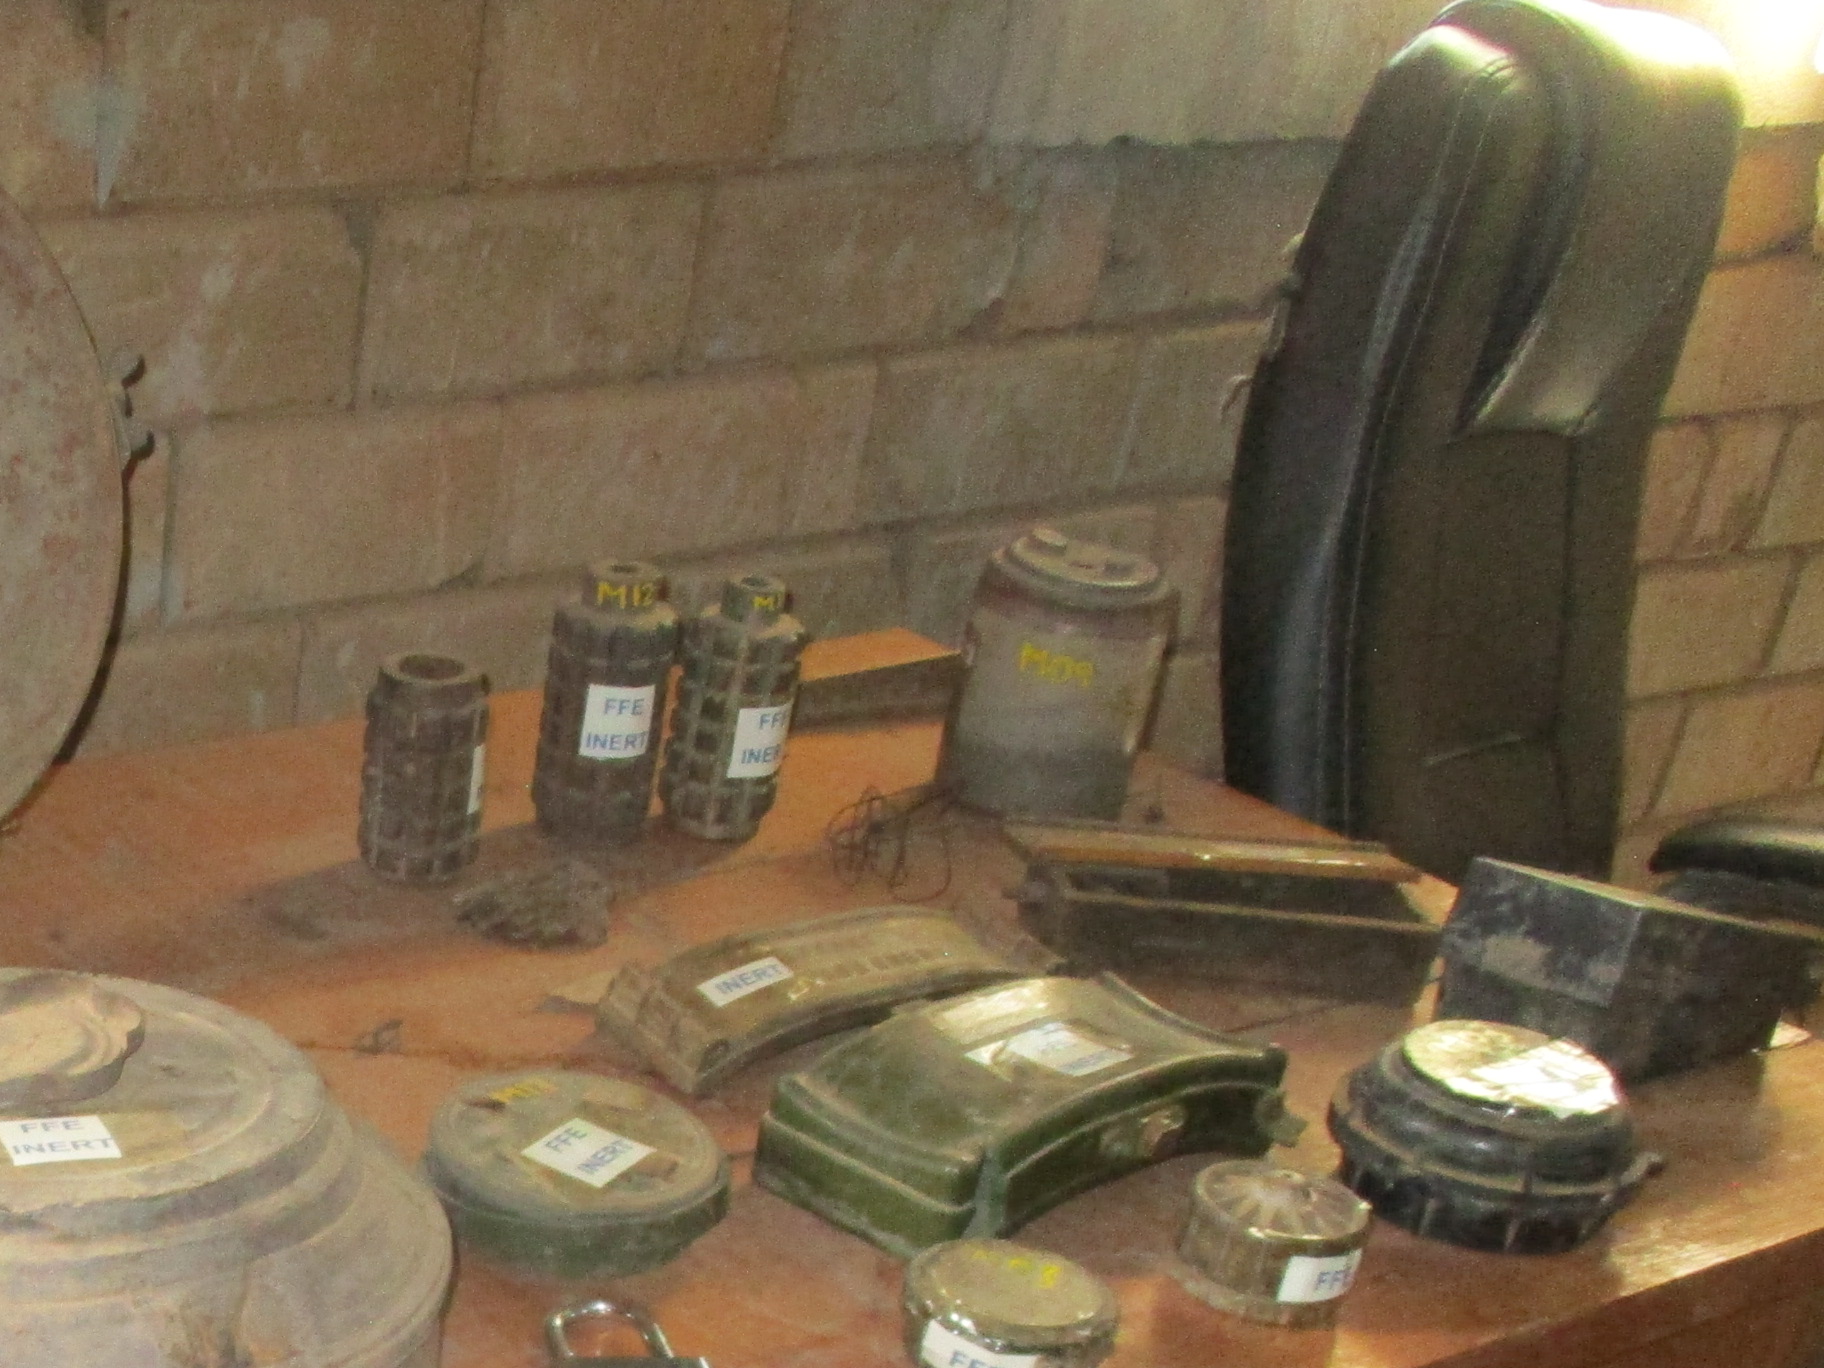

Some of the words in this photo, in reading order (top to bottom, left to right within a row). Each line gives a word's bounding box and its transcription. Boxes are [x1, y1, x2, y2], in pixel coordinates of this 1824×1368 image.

[604, 698, 646, 716] FFE
[585, 731, 648, 751] INERT
[715, 963, 782, 995] INERT
[20, 1119, 84, 1134] FFE
[12, 1137, 113, 1156] INERT
[544, 1126, 588, 1153] FFE
[577, 1138, 634, 1175] INERT
